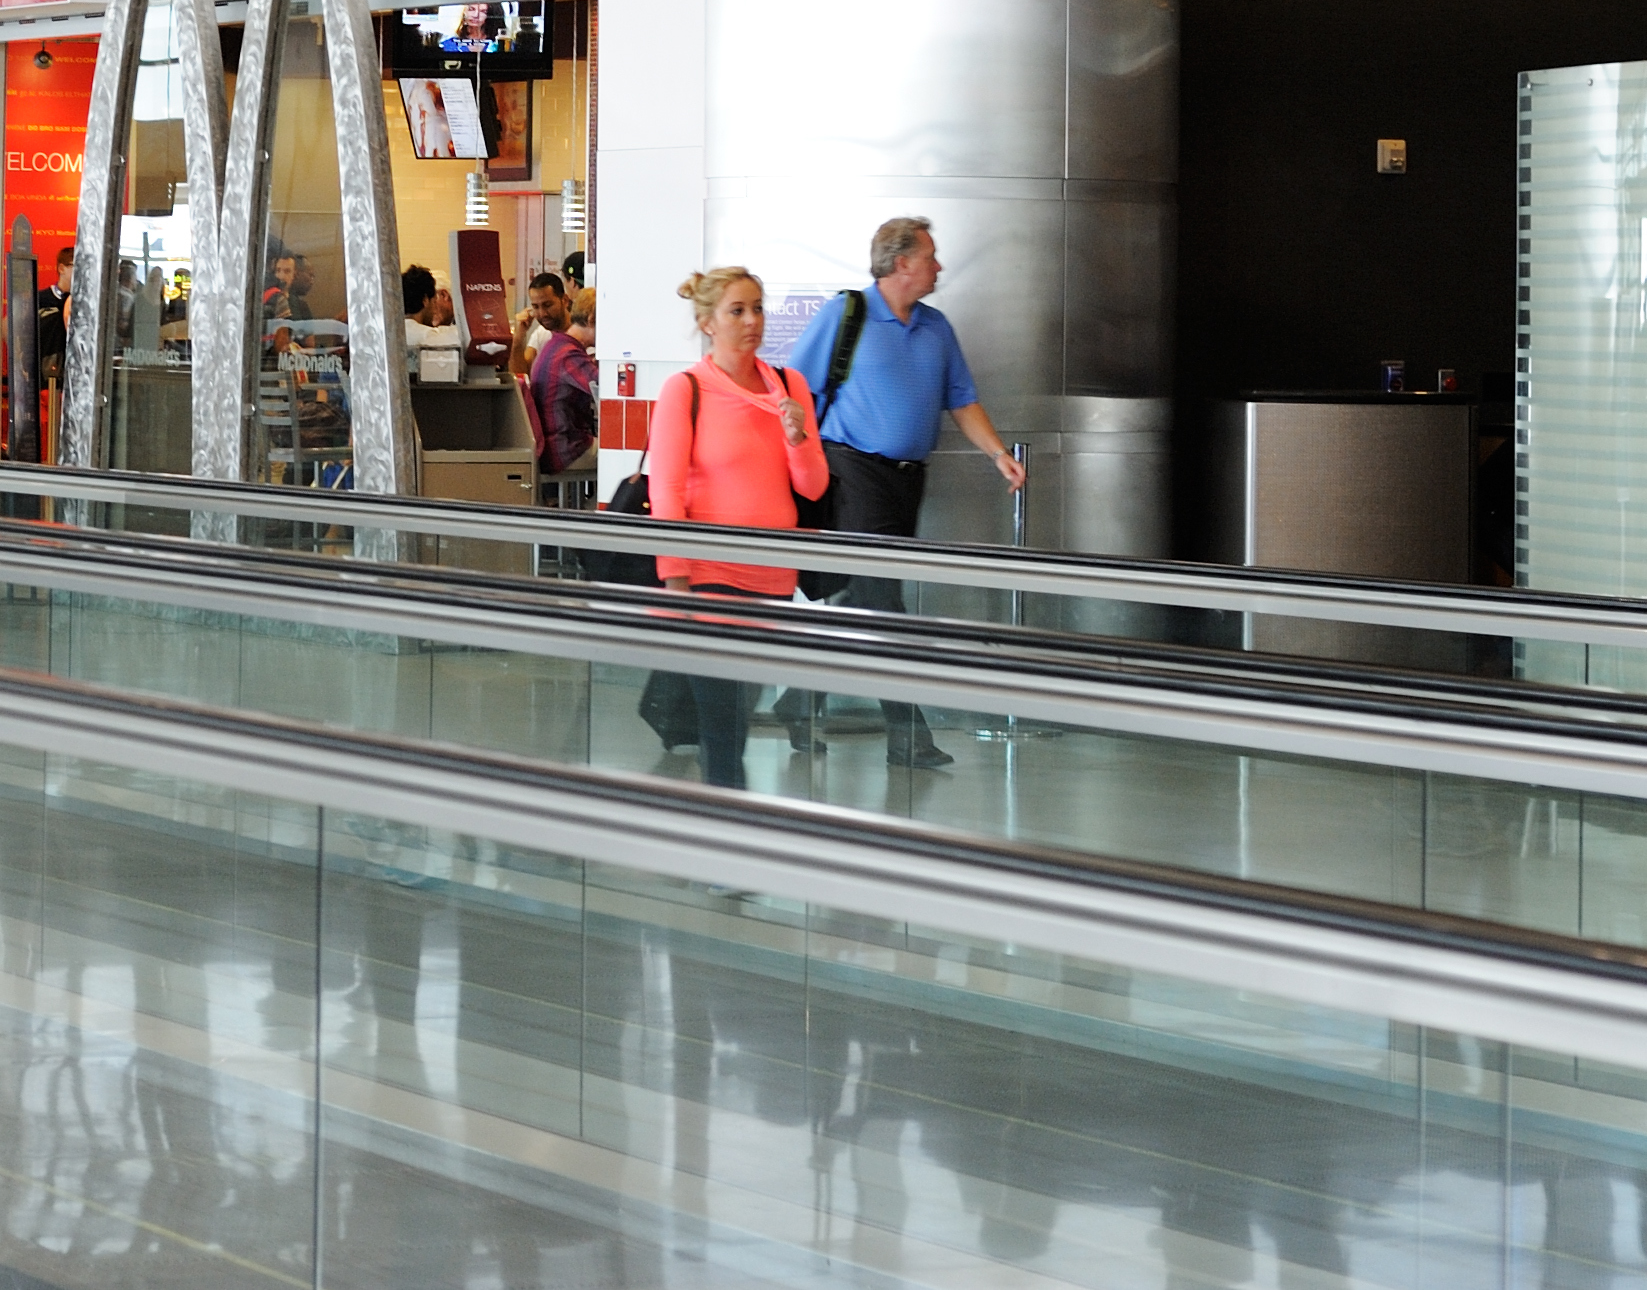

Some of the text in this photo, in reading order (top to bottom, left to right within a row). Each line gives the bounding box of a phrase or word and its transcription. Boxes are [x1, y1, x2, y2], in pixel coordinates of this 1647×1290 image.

[6, 152, 83, 172] ELCOM
[802, 300, 823, 316] TS
[278, 351, 343, 373] McDonald's
